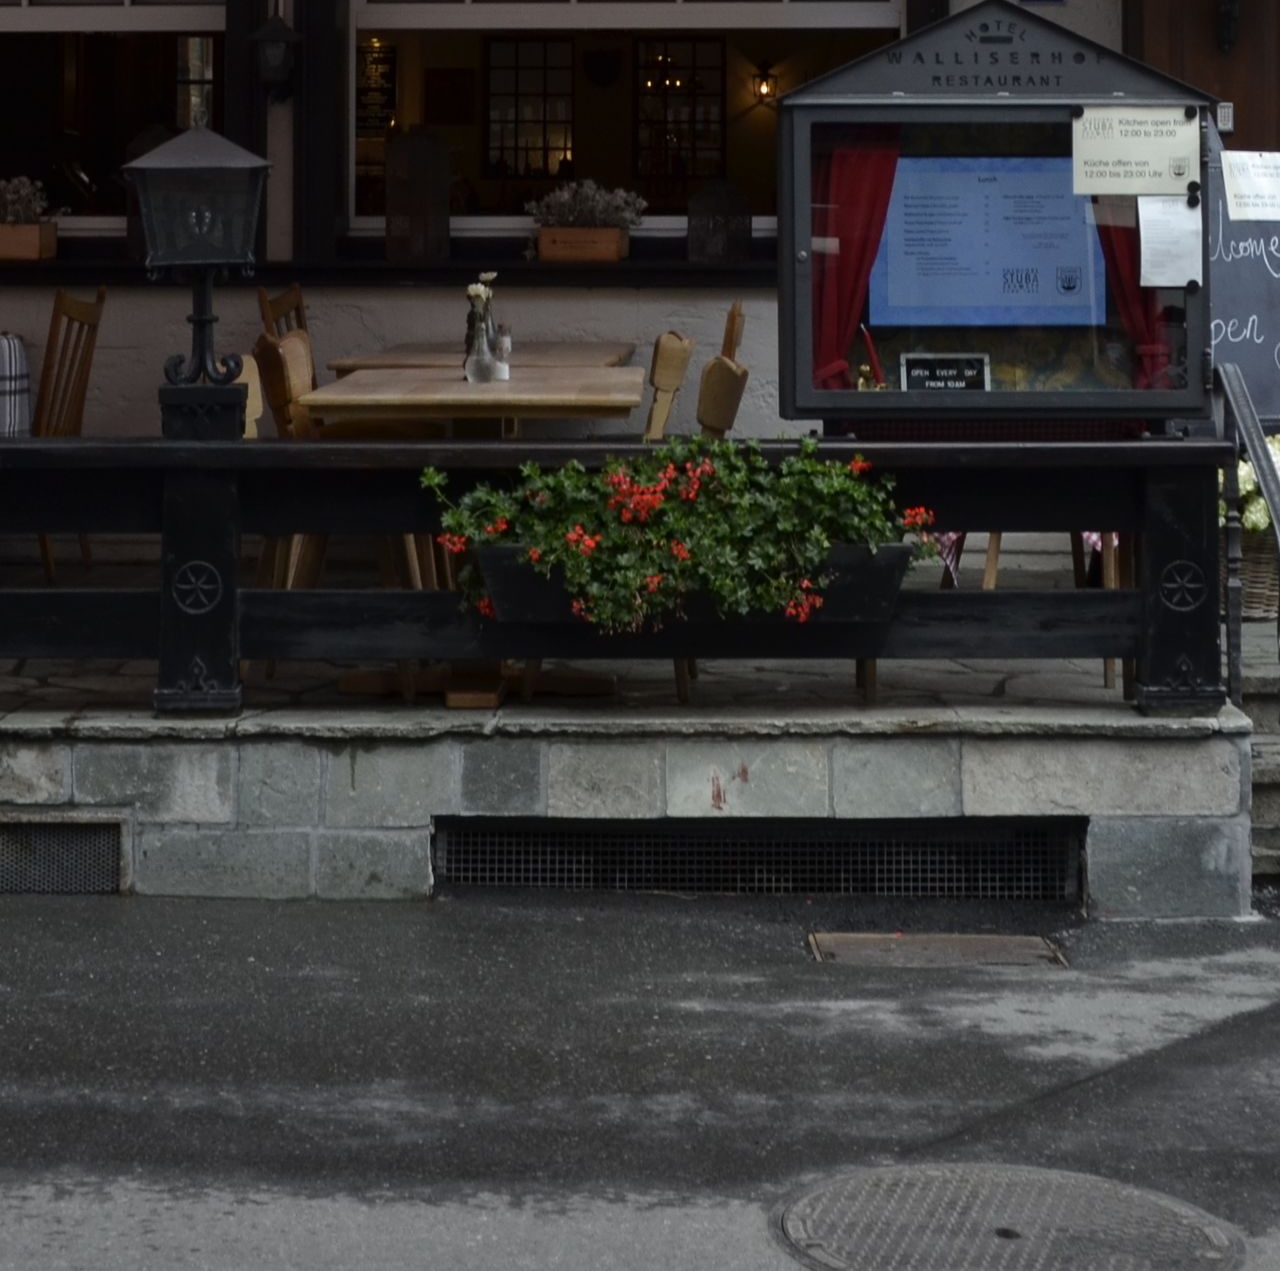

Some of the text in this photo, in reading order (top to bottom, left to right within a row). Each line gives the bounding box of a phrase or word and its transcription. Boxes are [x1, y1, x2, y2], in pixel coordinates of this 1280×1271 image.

[965, 19, 1027, 42] HOTEL
[887, 50, 1106, 65] WALLISERHOF
[932, 75, 1063, 87] RESTAURANT
[1118, 118, 1149, 127] Kitchen
[1151, 119, 1171, 128] open
[1173, 118, 1192, 127] from
[1144, 128, 1151, 137] to
[1083, 159, 1149, 168] Küche offen von
[1108, 170, 1121, 179] bis
[1148, 170, 1164, 179] Uhr
[1002, 273, 1040, 284] STUBA
[1210, 315, 1265, 363] pen
[911, 369, 978, 377] OPEN EVERY DAY
[925, 380, 945, 388] FROM
